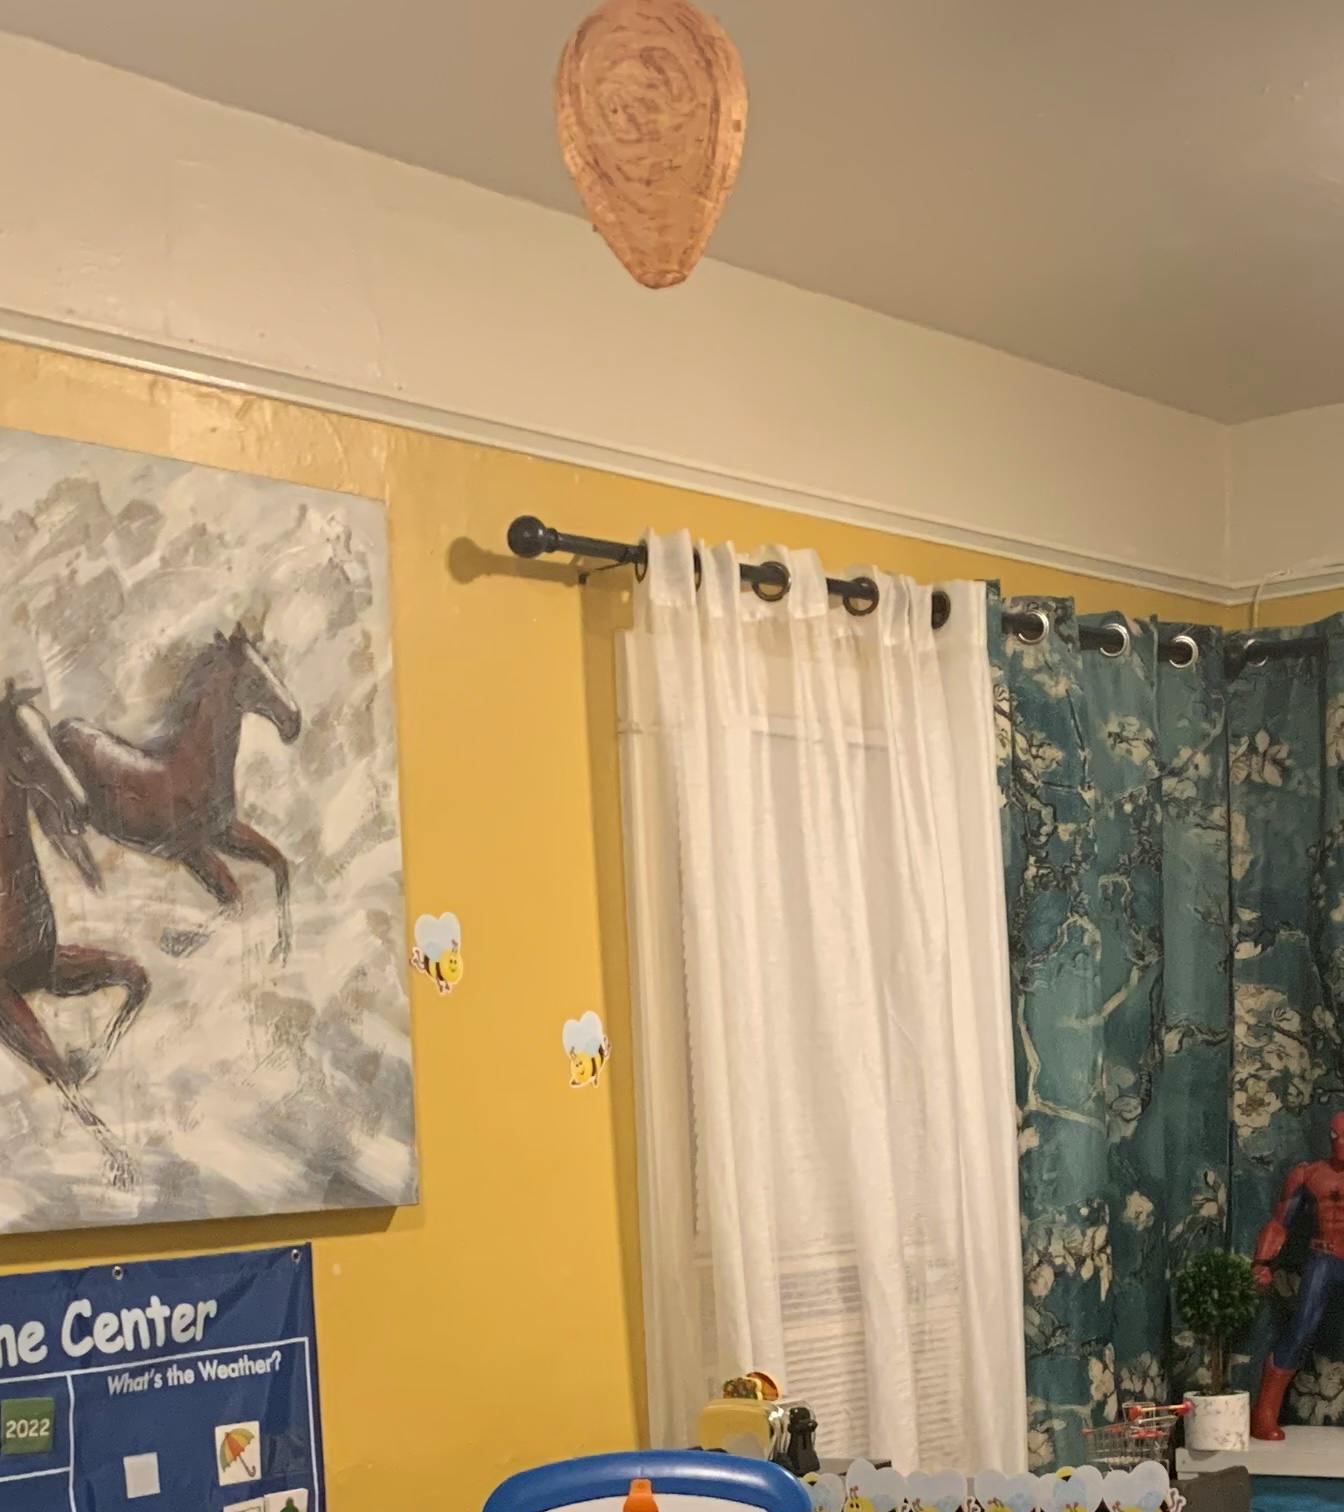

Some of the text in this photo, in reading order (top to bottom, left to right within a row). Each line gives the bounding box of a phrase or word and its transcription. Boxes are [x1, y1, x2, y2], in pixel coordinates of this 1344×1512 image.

[60, 1296, 217, 1357] Center
[108, 1350, 282, 1396] What's the Weather?
[5, 1418, 51, 1438] 2022
